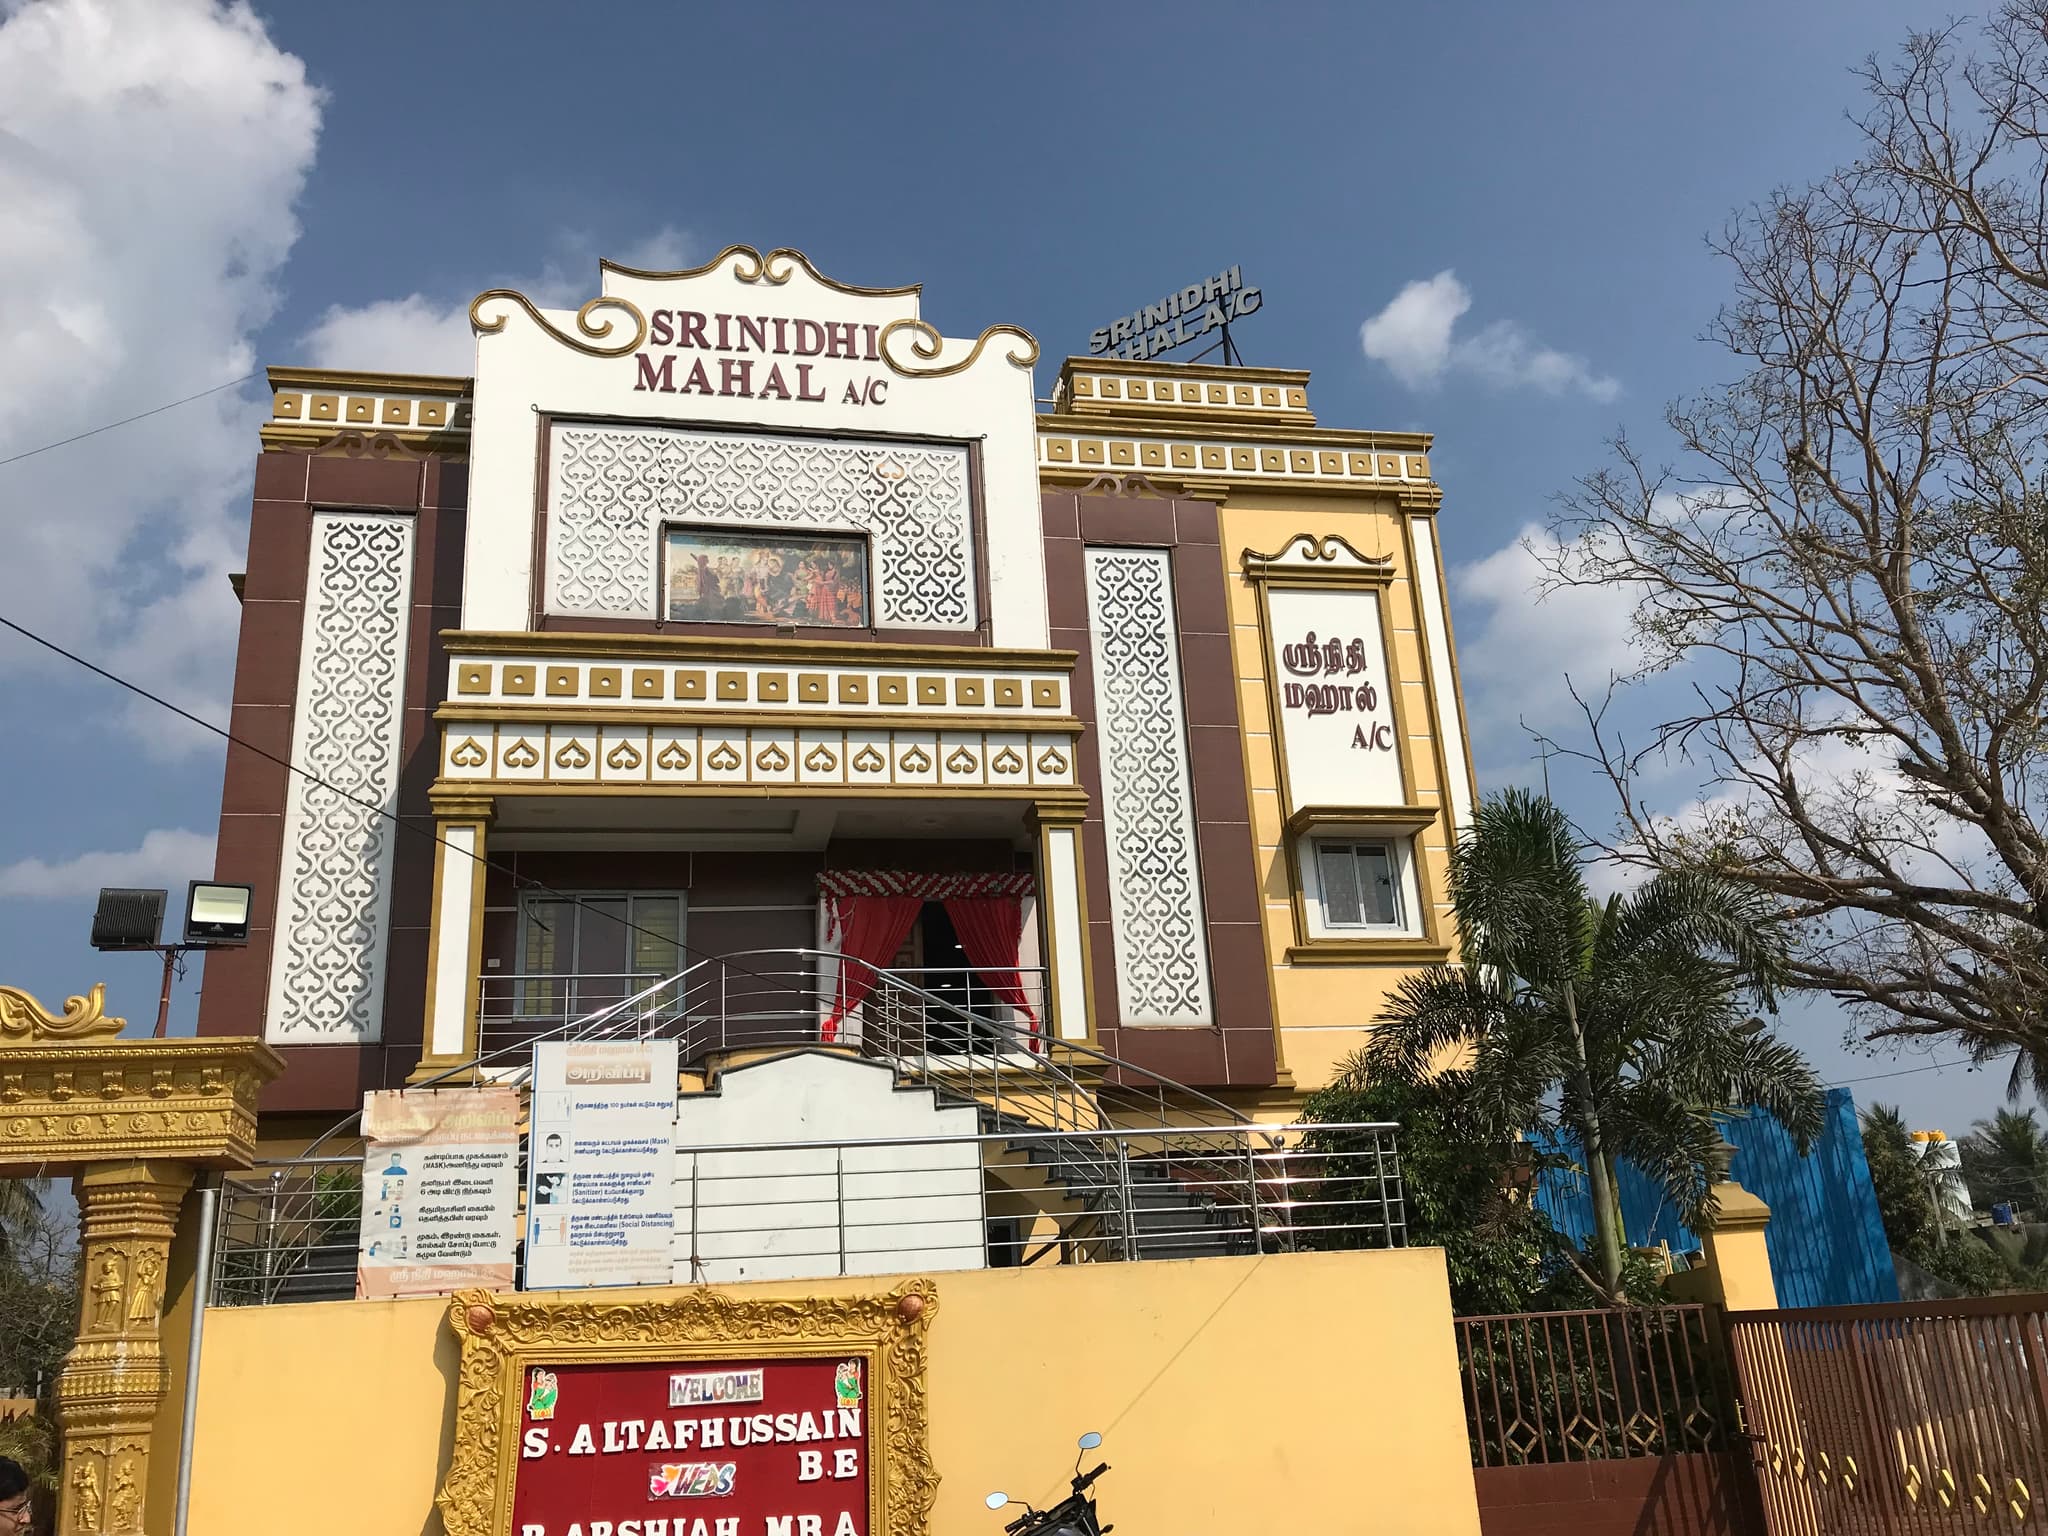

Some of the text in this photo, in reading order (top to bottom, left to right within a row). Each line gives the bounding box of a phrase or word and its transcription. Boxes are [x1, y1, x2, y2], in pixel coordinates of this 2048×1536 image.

[1089, 264, 1242, 354] SRINIDHI
[1202, 286, 1263, 335] A/C
[650, 309, 881, 361] SRINIDHI
[633, 353, 888, 406] MAHAL A/C
[1284, 681, 1377, 719] மஹால்
[1351, 721, 1393, 752] A/C
[567, 1064, 645, 1082] அறிவிப்பு
[619, 1220, 639, 1229] (Social
[641, 1220, 675, 1228] Distancing)
[670, 1374, 761, 1402] WELCOME
[675, 1464, 736, 1496] WEDS
[798, 1449, 858, 1481] B.E
